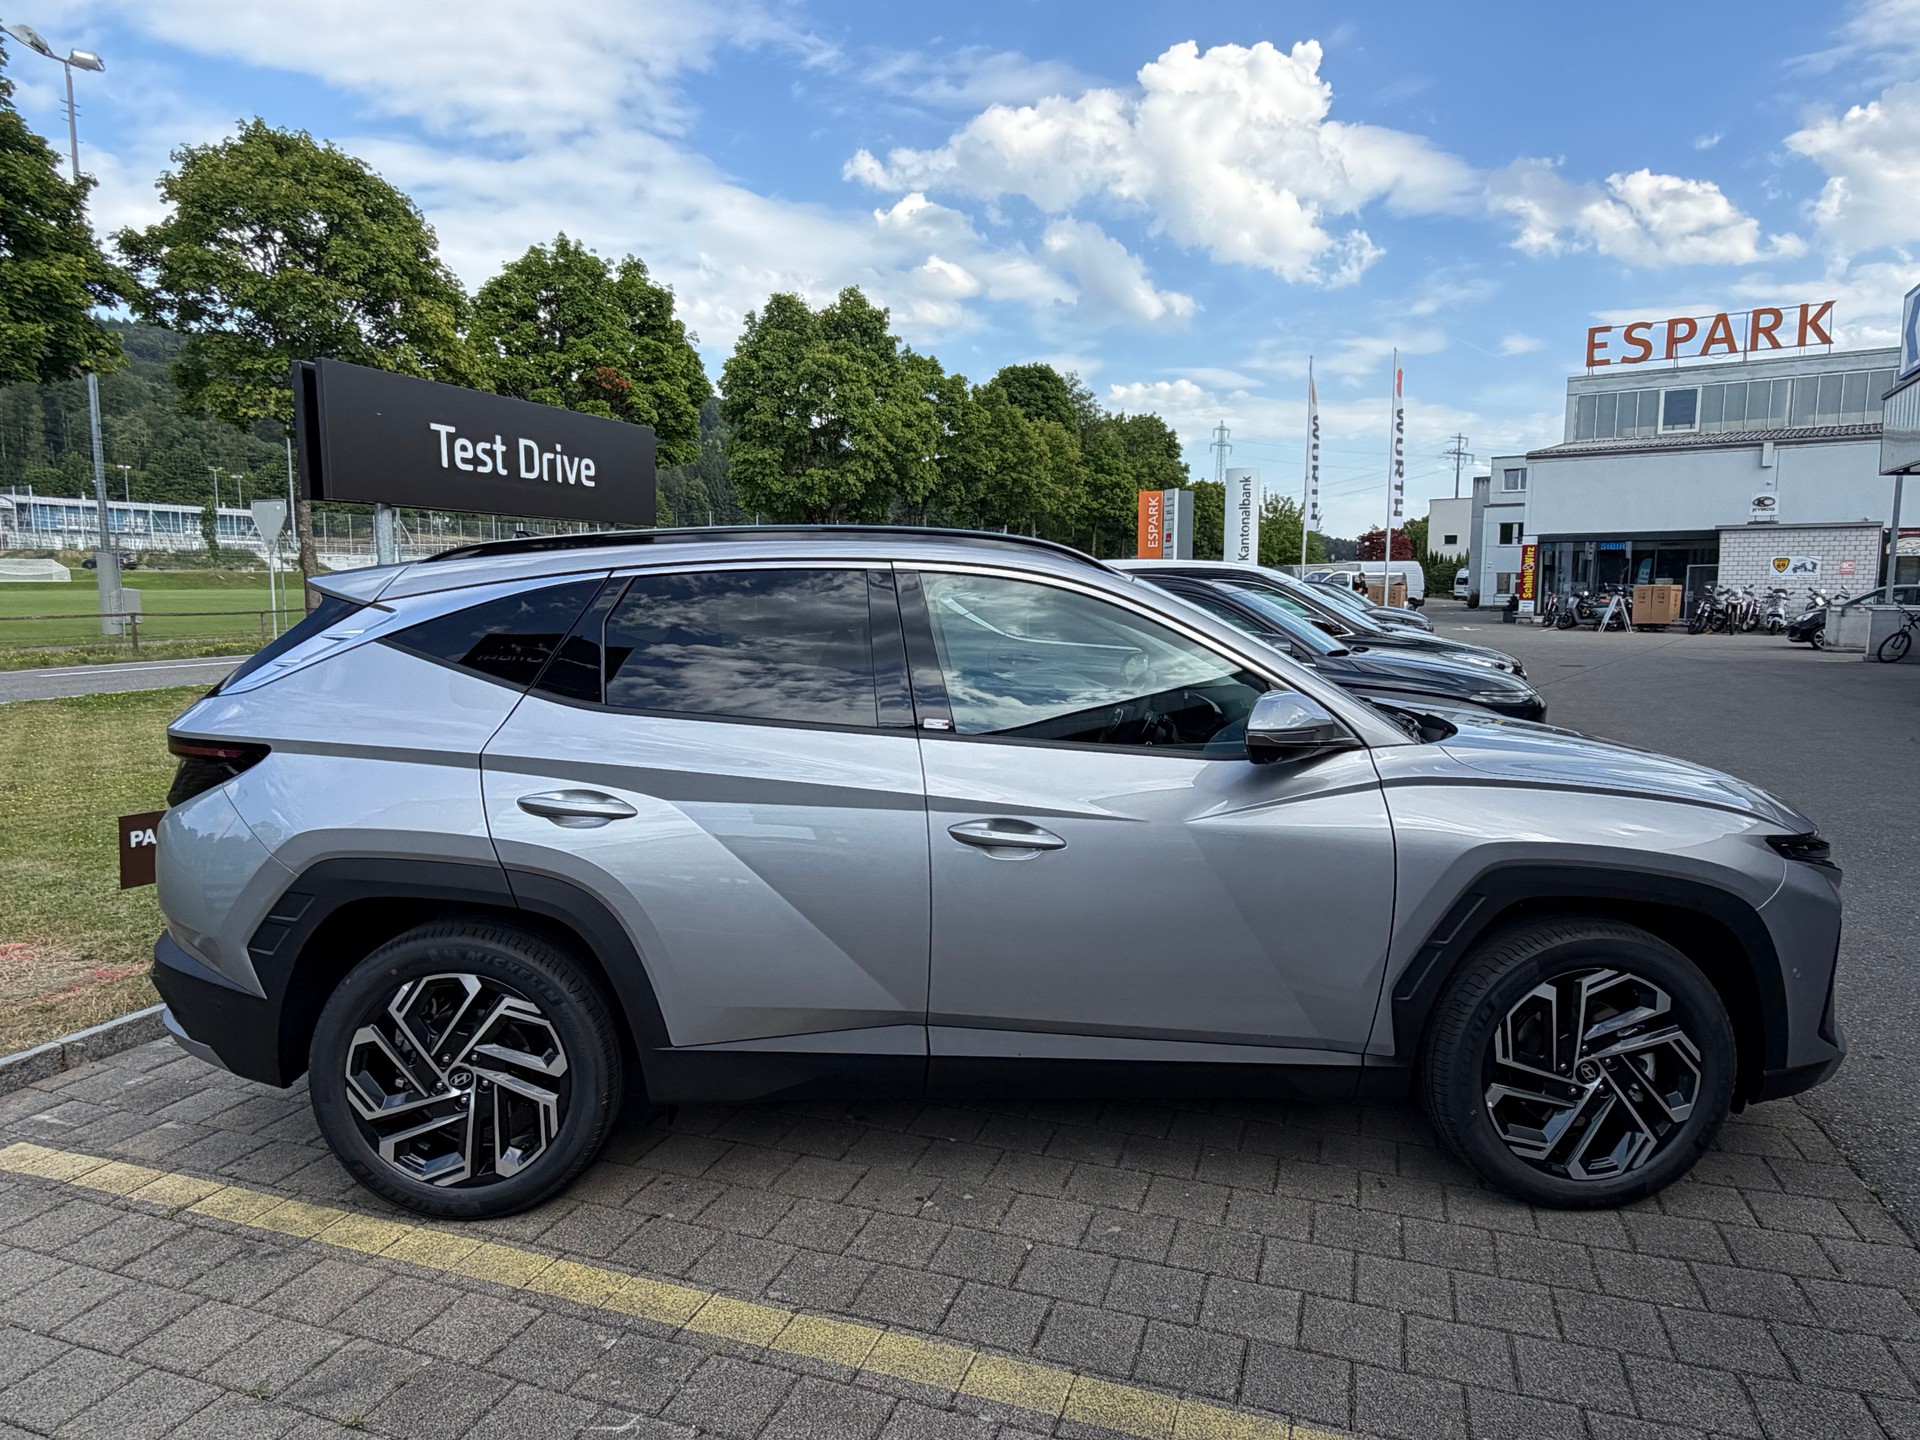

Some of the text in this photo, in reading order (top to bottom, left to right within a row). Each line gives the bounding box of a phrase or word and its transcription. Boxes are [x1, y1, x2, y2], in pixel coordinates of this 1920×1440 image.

[1586, 300, 1837, 367] ESPARK
[429, 422, 596, 487] Test Drive
[1147, 495, 1159, 548] ESPARK
[1237, 475, 1252, 561] Kantonalbank
